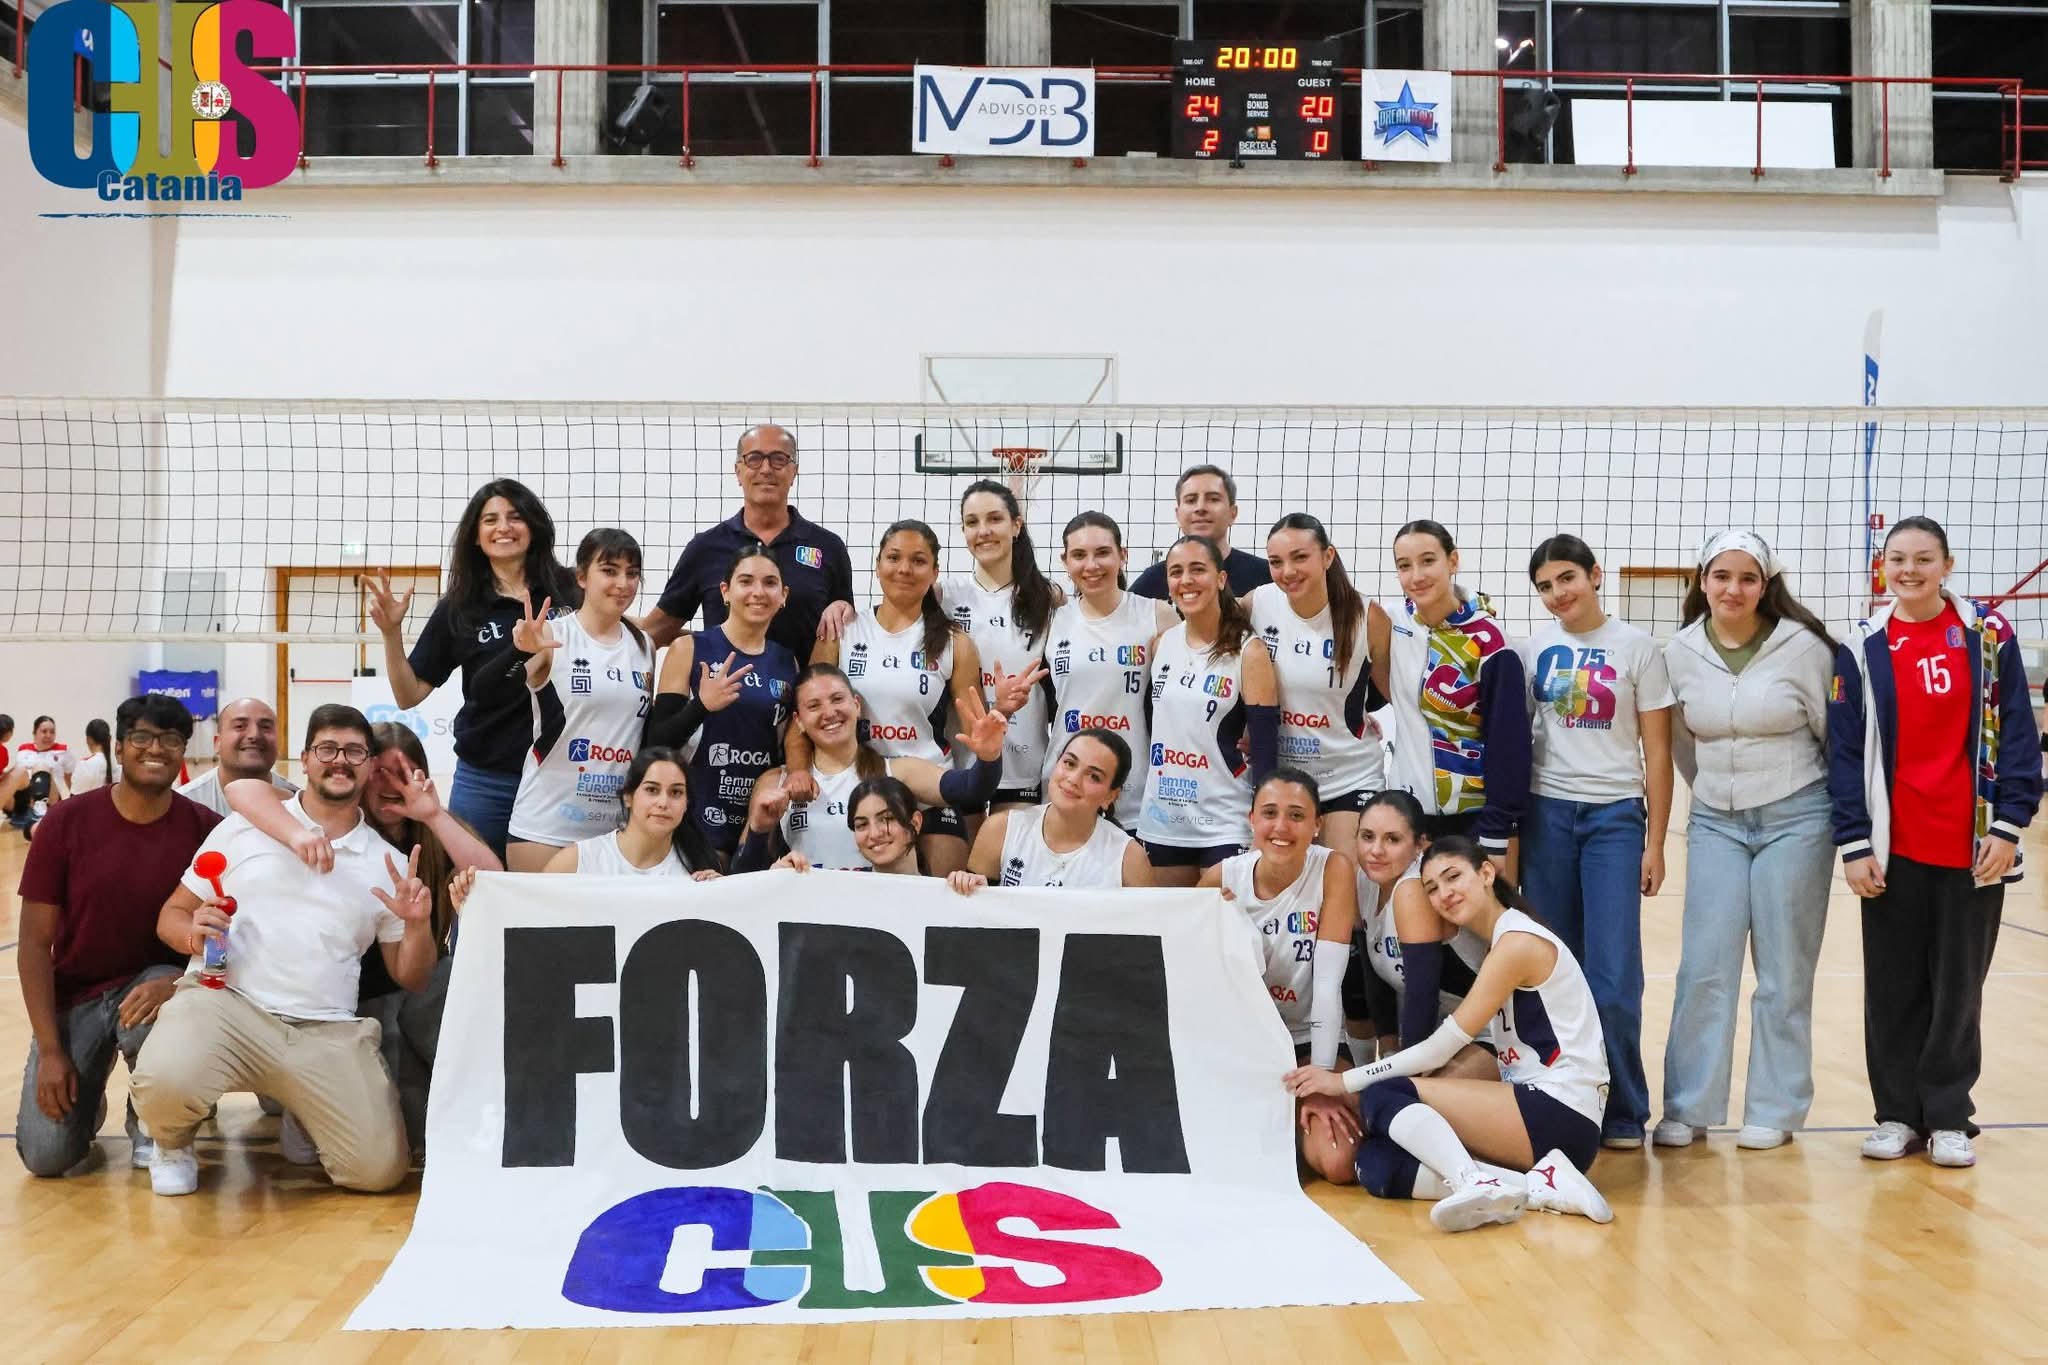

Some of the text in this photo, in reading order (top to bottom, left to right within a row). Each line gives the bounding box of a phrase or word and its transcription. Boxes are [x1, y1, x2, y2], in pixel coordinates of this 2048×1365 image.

[1216, 47, 1297, 69] 20:00
[1185, 77, 1216, 87] HOME
[1297, 78, 1333, 88] GUEST
[978, 103, 1057, 116] ADVISORS
[1186, 95, 1221, 117] 24
[1246, 100, 1269, 110] BONUS
[1300, 96, 1334, 118] 20
[1203, 130, 1219, 151] 2
[1313, 130, 1329, 151] 0
[919, 673, 929, 695] 8
[1123, 671, 1141, 694] 15
[1917, 654, 1952, 695] 15
[1205, 699, 1218, 722] 9
[1281, 710, 1330, 729] ROGA
[872, 725, 918, 740] ROGA
[1080, 715, 1131, 731] ROGA
[589, 744, 633, 763] ROGA
[729, 749, 771, 766] ROGA
[1164, 749, 1209, 769] ROGA
[578, 766, 625, 785] iemme
[720, 769, 757, 788] iemm
[1158, 770, 1198, 789] iemme
[1158, 786, 1198, 800] EUROPA
[1292, 939, 1314, 962] 23
[502, 918, 1192, 1174] FORZA
[561, 1181, 1163, 1314] CUS
